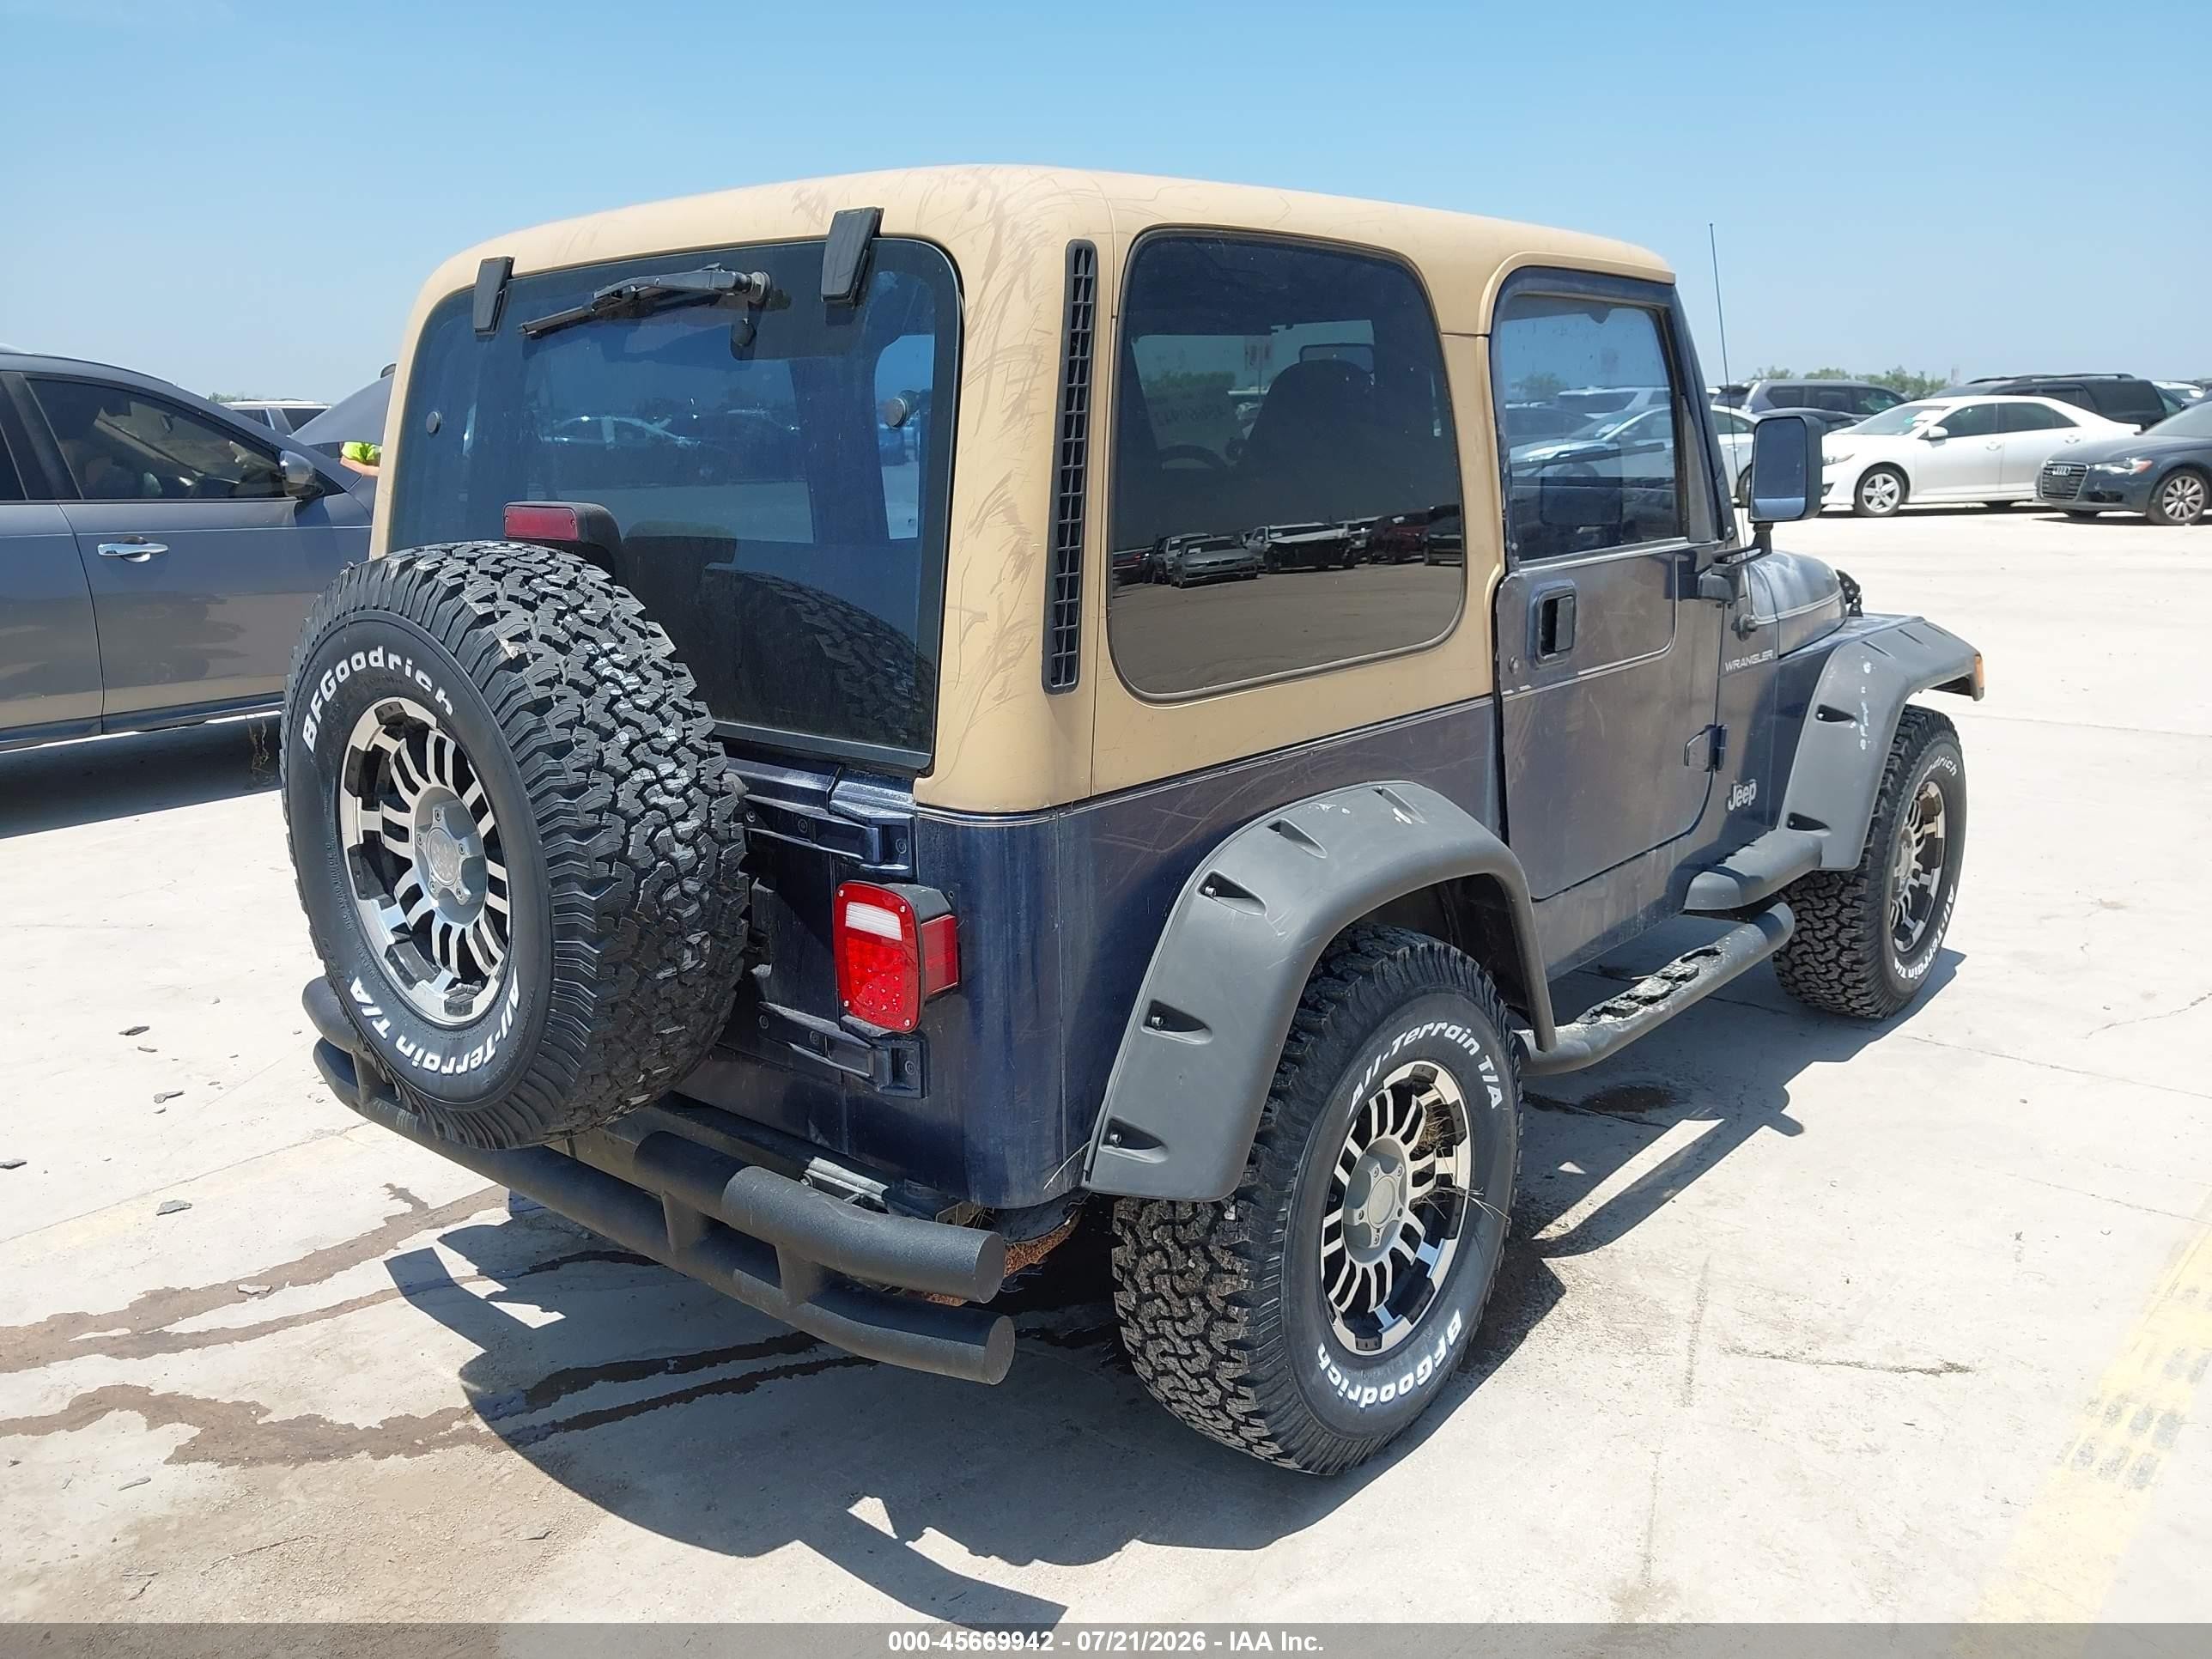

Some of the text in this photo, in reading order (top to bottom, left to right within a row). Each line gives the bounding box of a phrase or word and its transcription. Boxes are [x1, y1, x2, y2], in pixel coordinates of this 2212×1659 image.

[302, 645, 453, 753] BFGoodrich
[1724, 649, 1773, 672] WRANGLER
[1728, 782, 1757, 811] Jeep
[349, 976, 392, 1039] T/A
[395, 966, 520, 1074] All-Terrain
[1346, 1022, 1503, 1120] All-Terrain T/A
[1317, 1310, 1462, 1408] BFGoodrich
